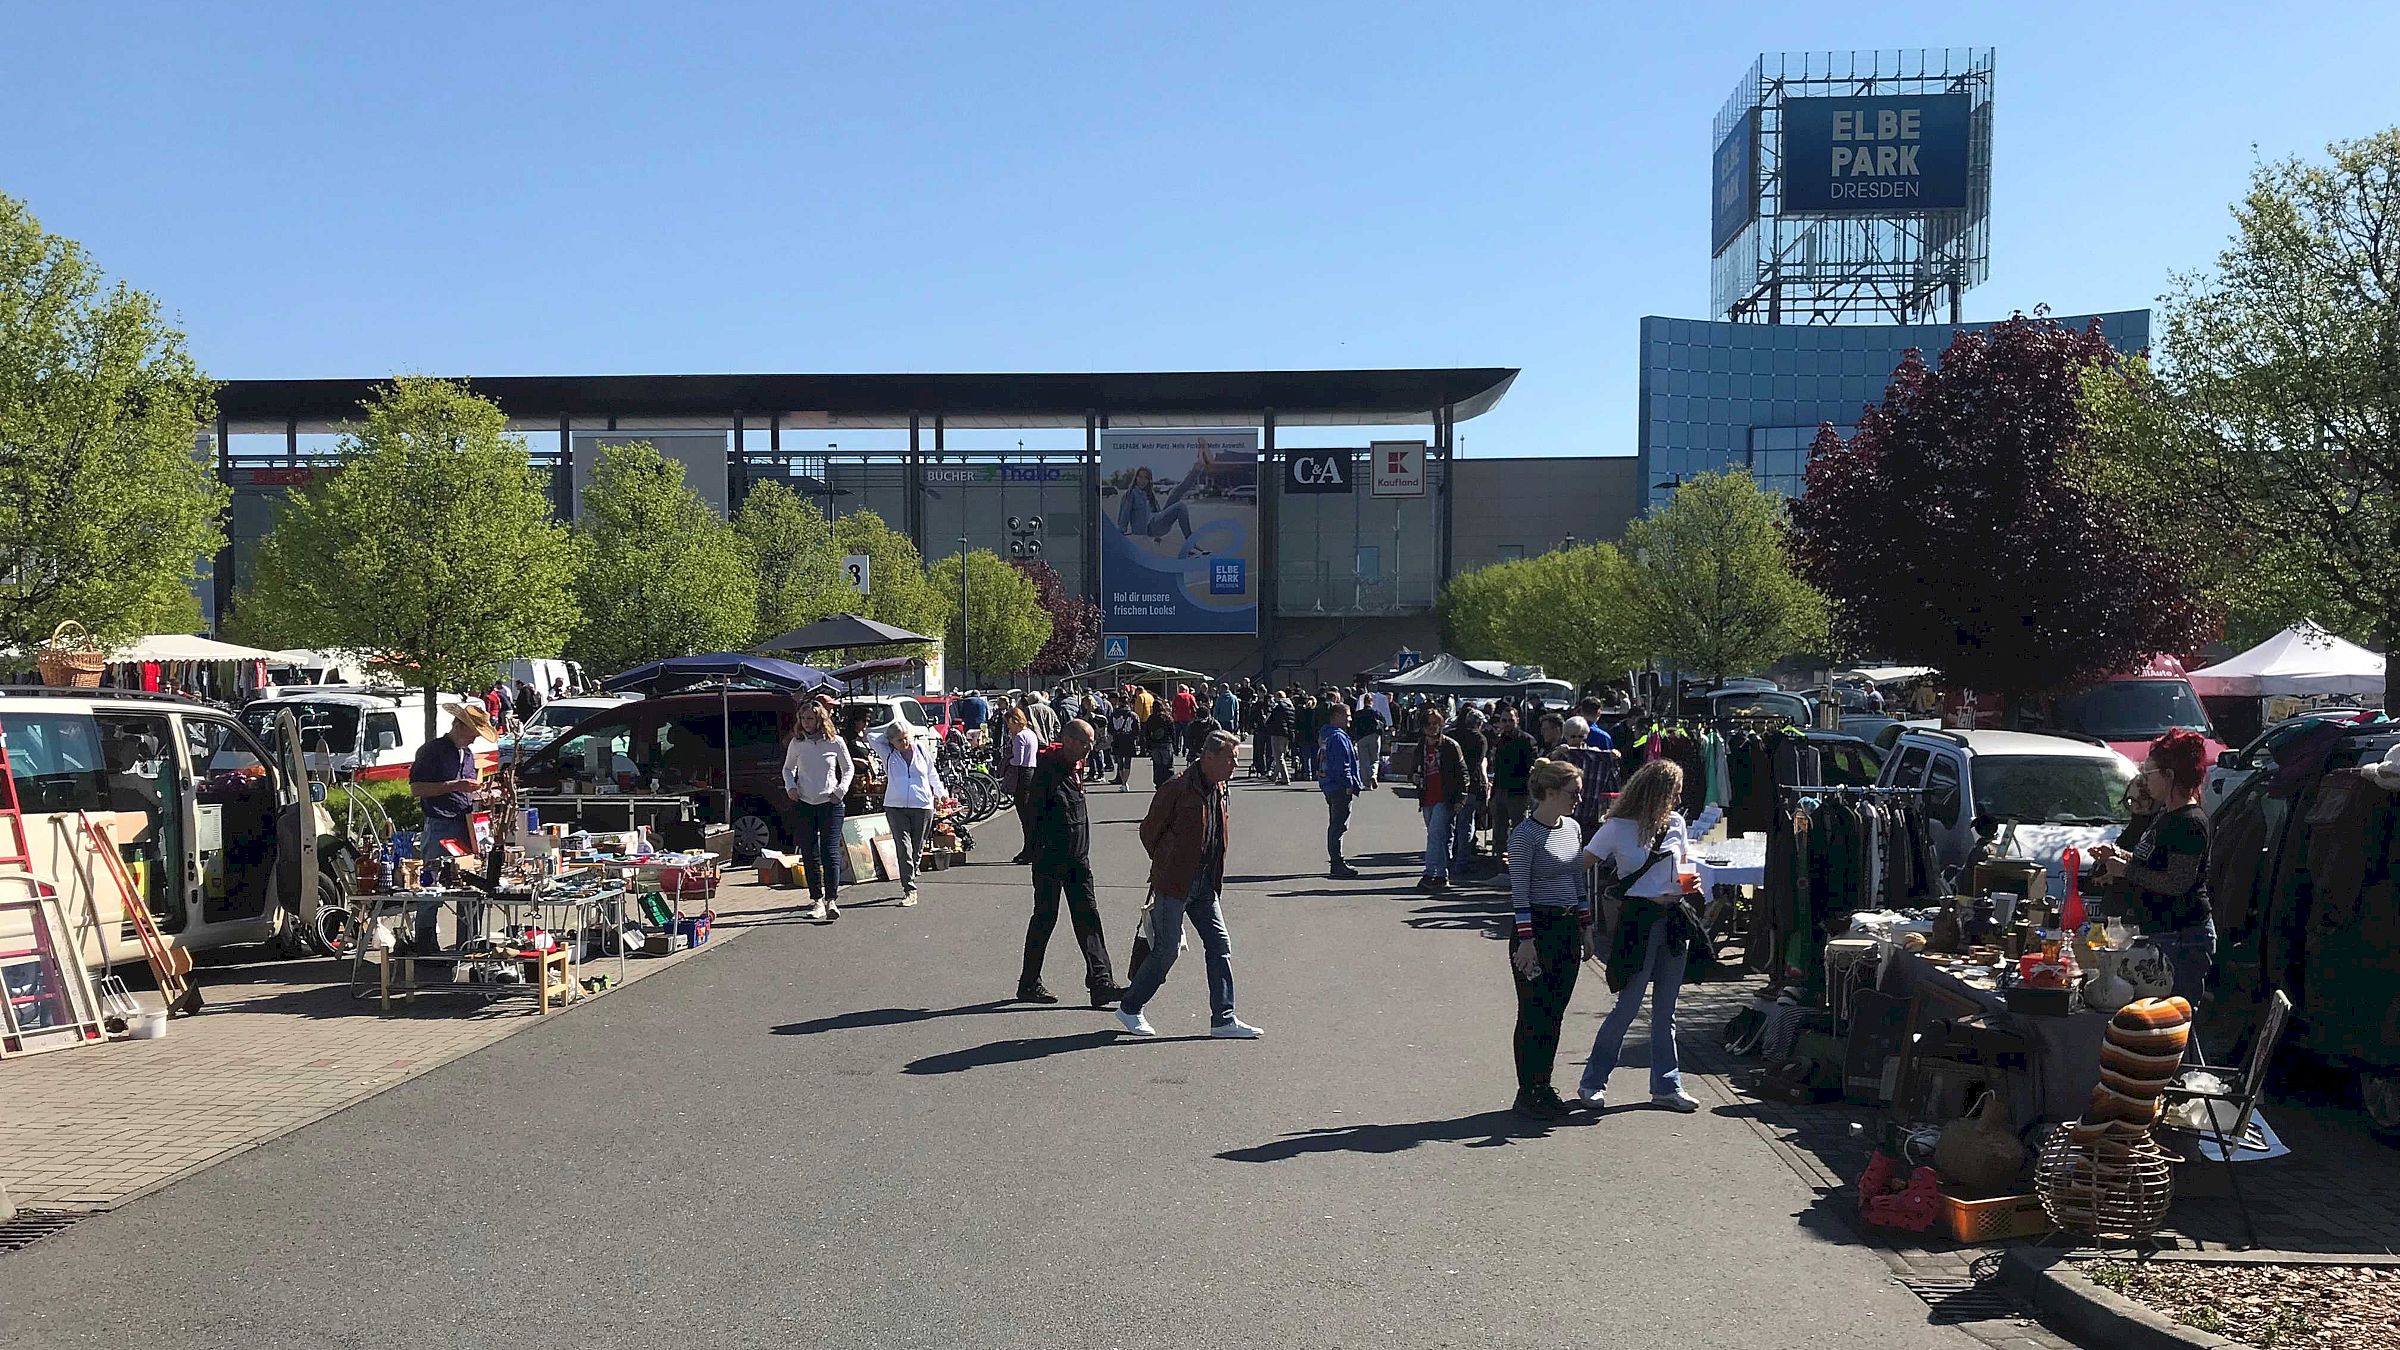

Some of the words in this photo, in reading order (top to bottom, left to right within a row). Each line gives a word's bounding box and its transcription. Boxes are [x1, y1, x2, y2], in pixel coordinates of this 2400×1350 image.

[1832, 109, 1920, 141] ELBE
[1831, 145, 1920, 177] PARK
[1831, 181, 1919, 199] DRESDEN
[927, 469, 975, 482] BÜCHER
[1293, 456, 1344, 484] C&A
[1377, 478, 1420, 488] Kaufland
[848, 564, 861, 586] 3
[1216, 565, 1239, 574] ELBE
[1216, 574, 1239, 583] PARK
[1113, 592, 1127, 602] Hol
[1129, 592, 1140, 602] dir
[1142, 593, 1170, 602] unsere
[1114, 605, 1148, 615] frischen
[1149, 605, 1176, 616] Looks!
